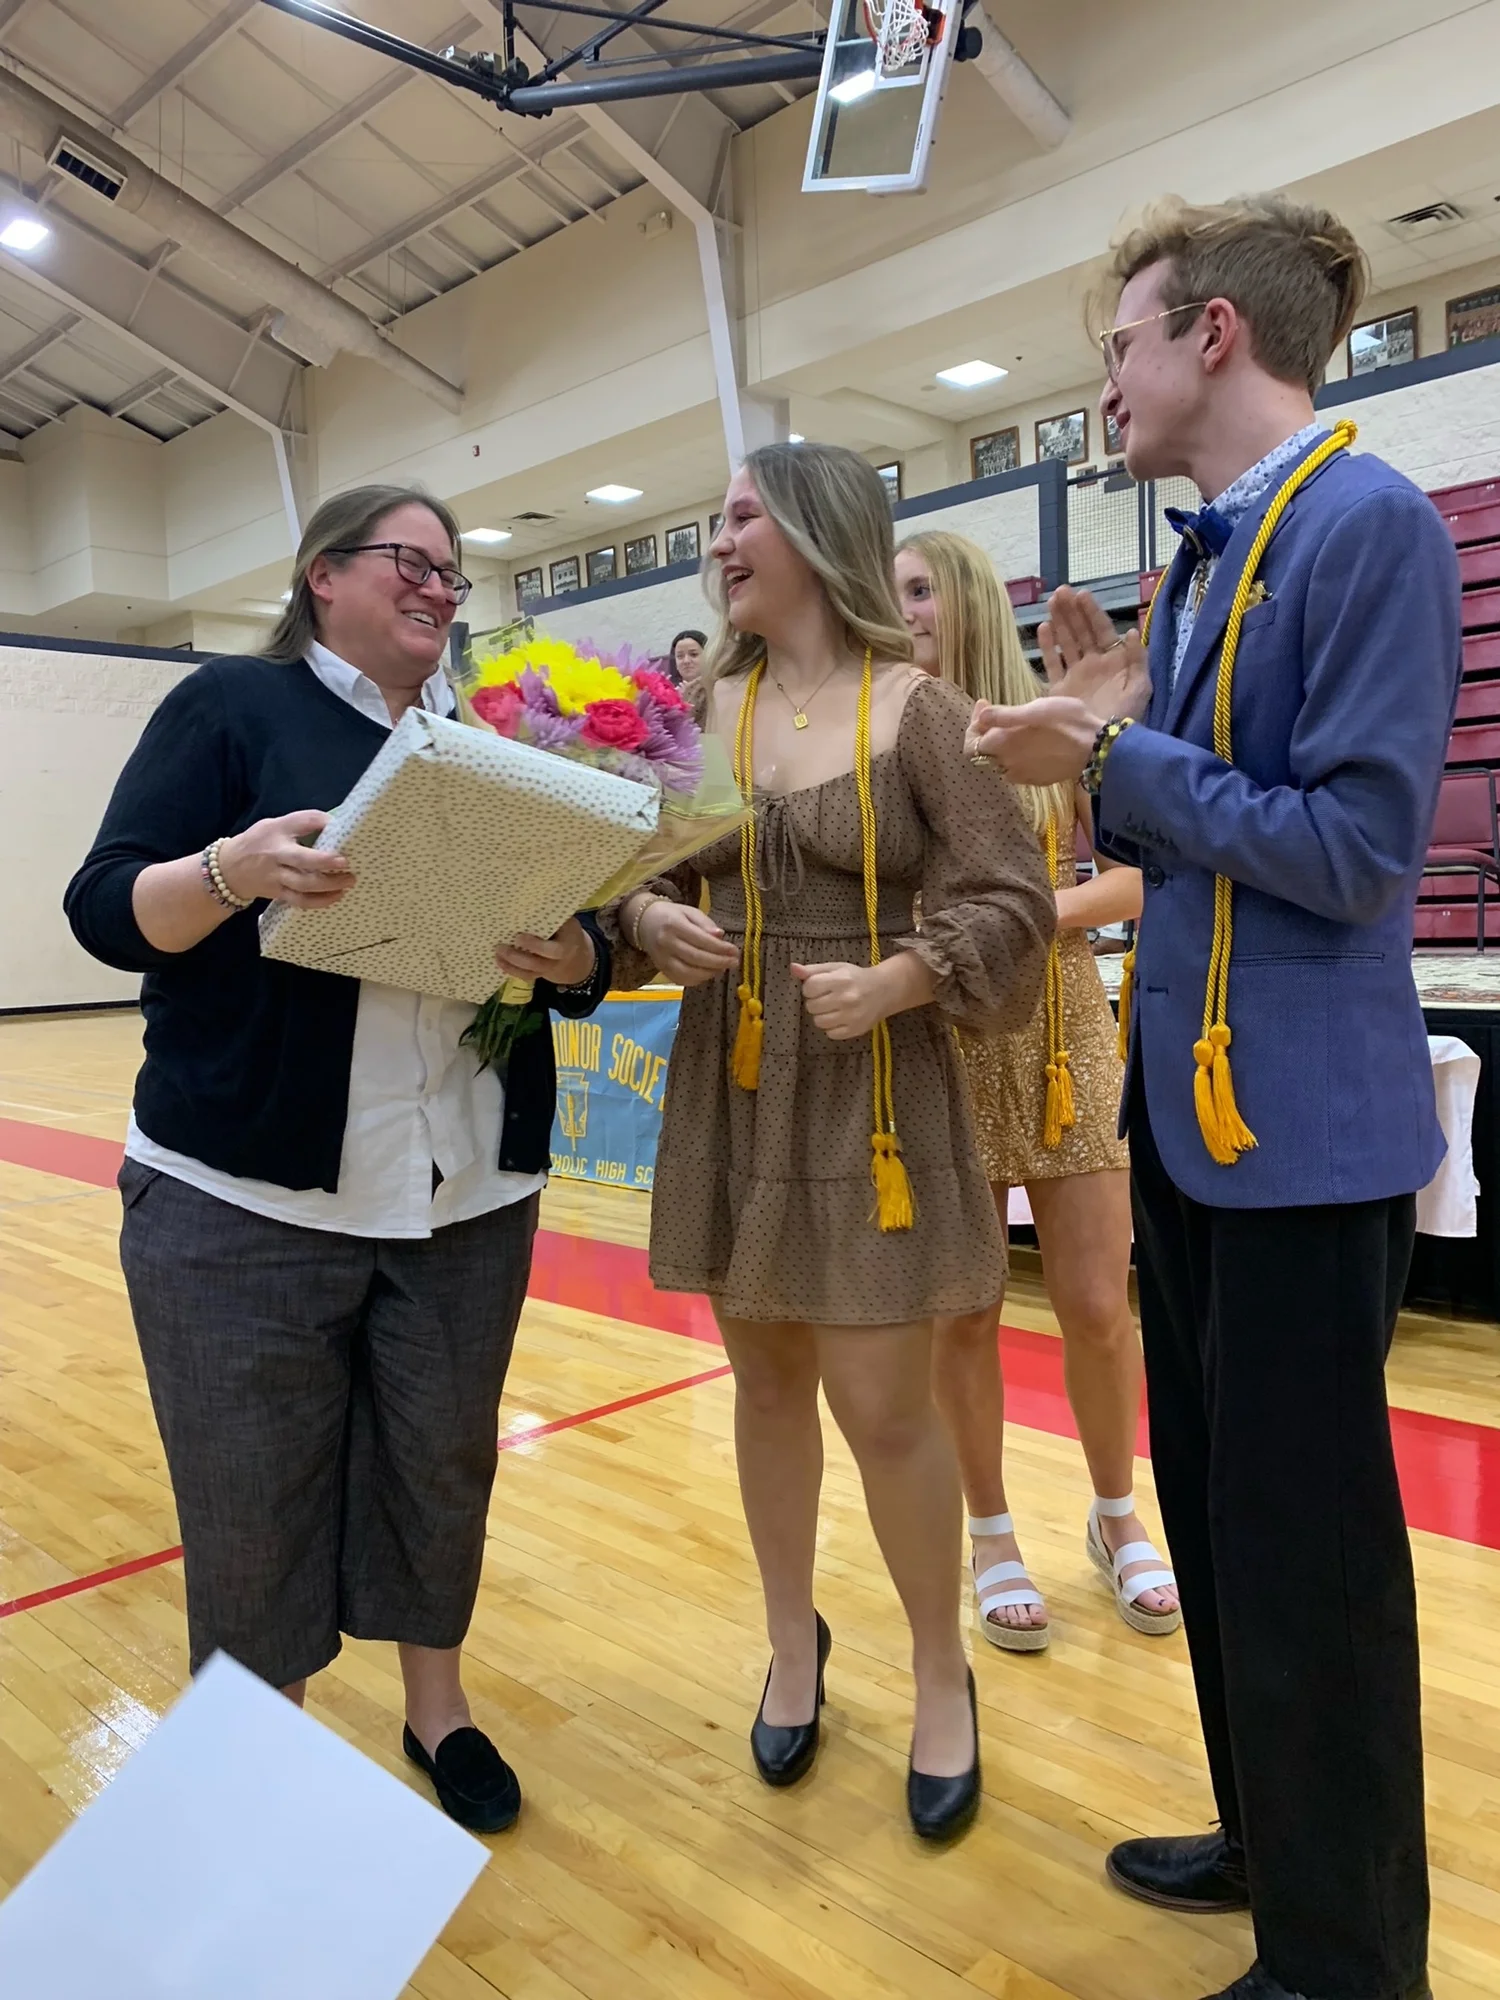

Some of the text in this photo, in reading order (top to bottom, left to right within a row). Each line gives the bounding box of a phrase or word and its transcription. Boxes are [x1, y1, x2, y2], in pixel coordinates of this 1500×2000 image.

[607, 1032, 668, 1112] SOCIE
[595, 1159, 627, 1181] HIGH
[634, 1165, 654, 1184] SC
